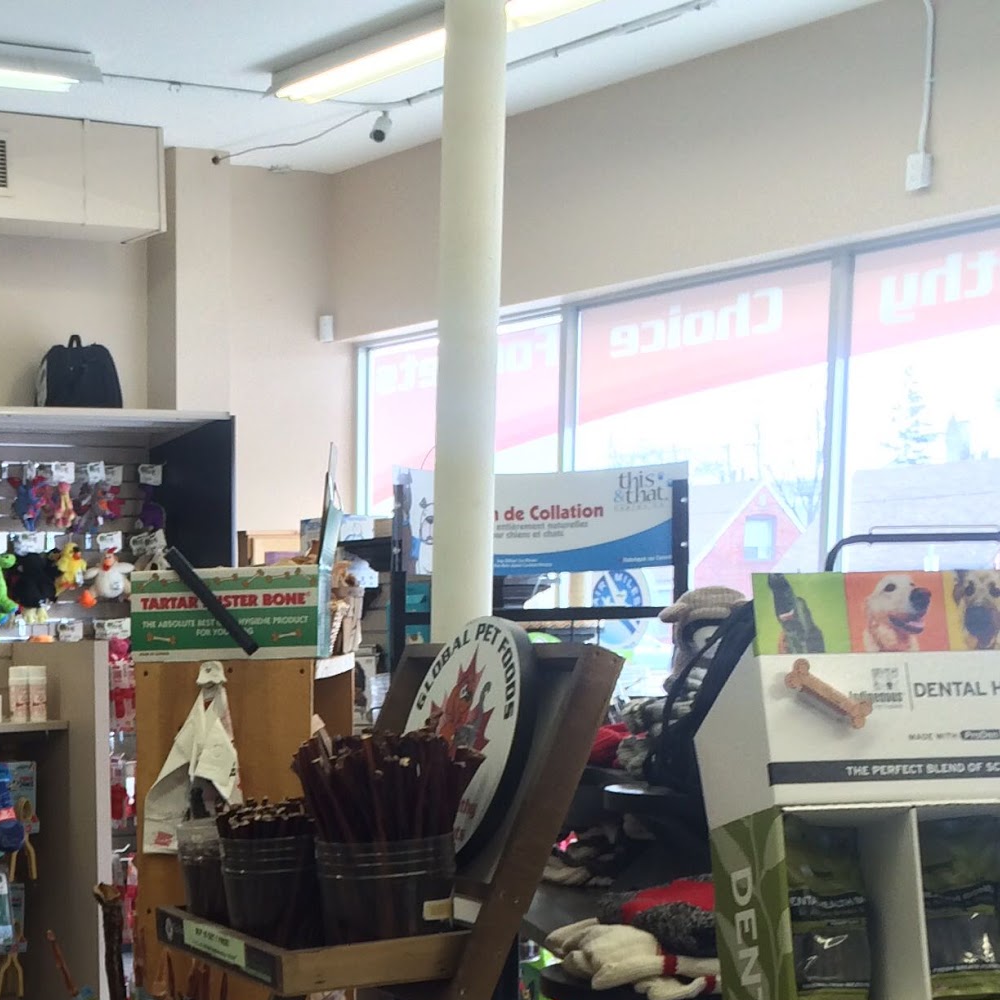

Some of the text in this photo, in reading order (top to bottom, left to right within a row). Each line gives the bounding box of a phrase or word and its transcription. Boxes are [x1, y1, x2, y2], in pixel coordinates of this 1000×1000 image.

[618, 470, 655, 489] this
[504, 506, 524, 521] de
[530, 504, 604, 521] Collation
[140, 596, 198, 610] TARTAR
[262, 593, 306, 606] BONE
[142, 620, 156, 628] THE
[158, 619, 195, 628] ABSOLUTE
[197, 618, 215, 627] BEST
[272, 615, 309, 625] PRODUCT
[196, 628, 212, 636] FOR
[416, 622, 517, 720] GLOBAL PET FOODS
[913, 681, 987, 697] DENTAL
[846, 761, 1000, 777] THE PERFECT BLEND OF SC
